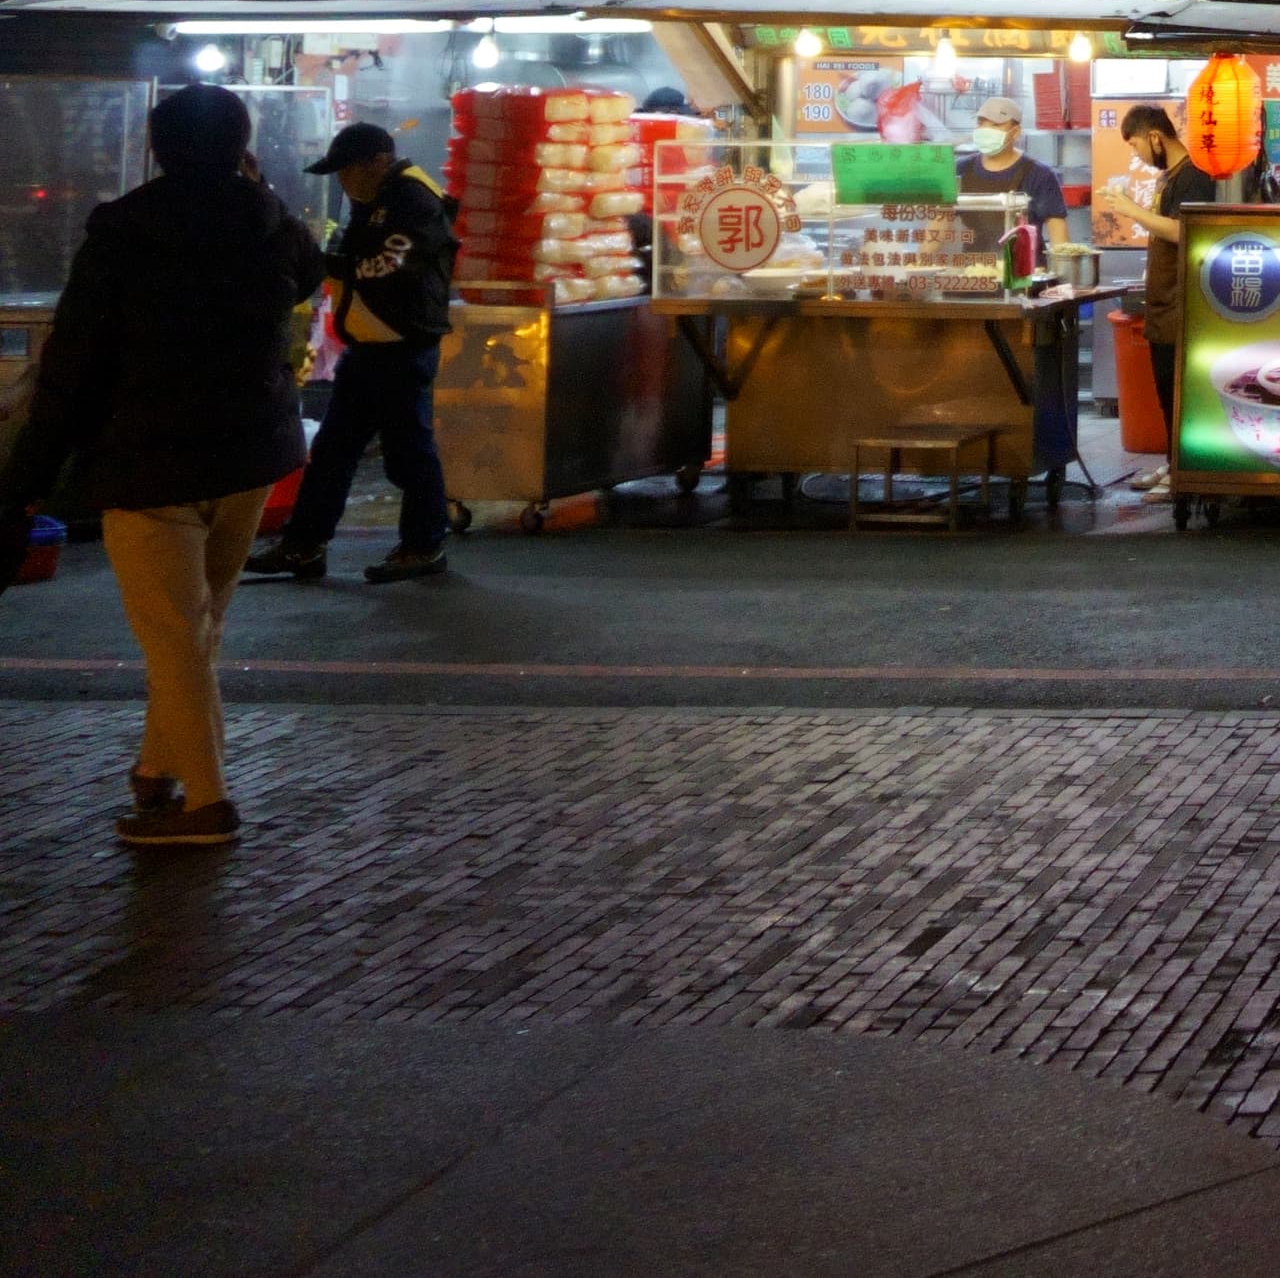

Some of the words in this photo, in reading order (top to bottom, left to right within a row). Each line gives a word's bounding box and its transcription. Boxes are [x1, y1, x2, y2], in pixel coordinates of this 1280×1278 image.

[804, 84, 832, 99] 180
[804, 105, 831, 120] 190
[882, 203, 957, 222] 每份35元
[717, 205, 765, 254] 郭
